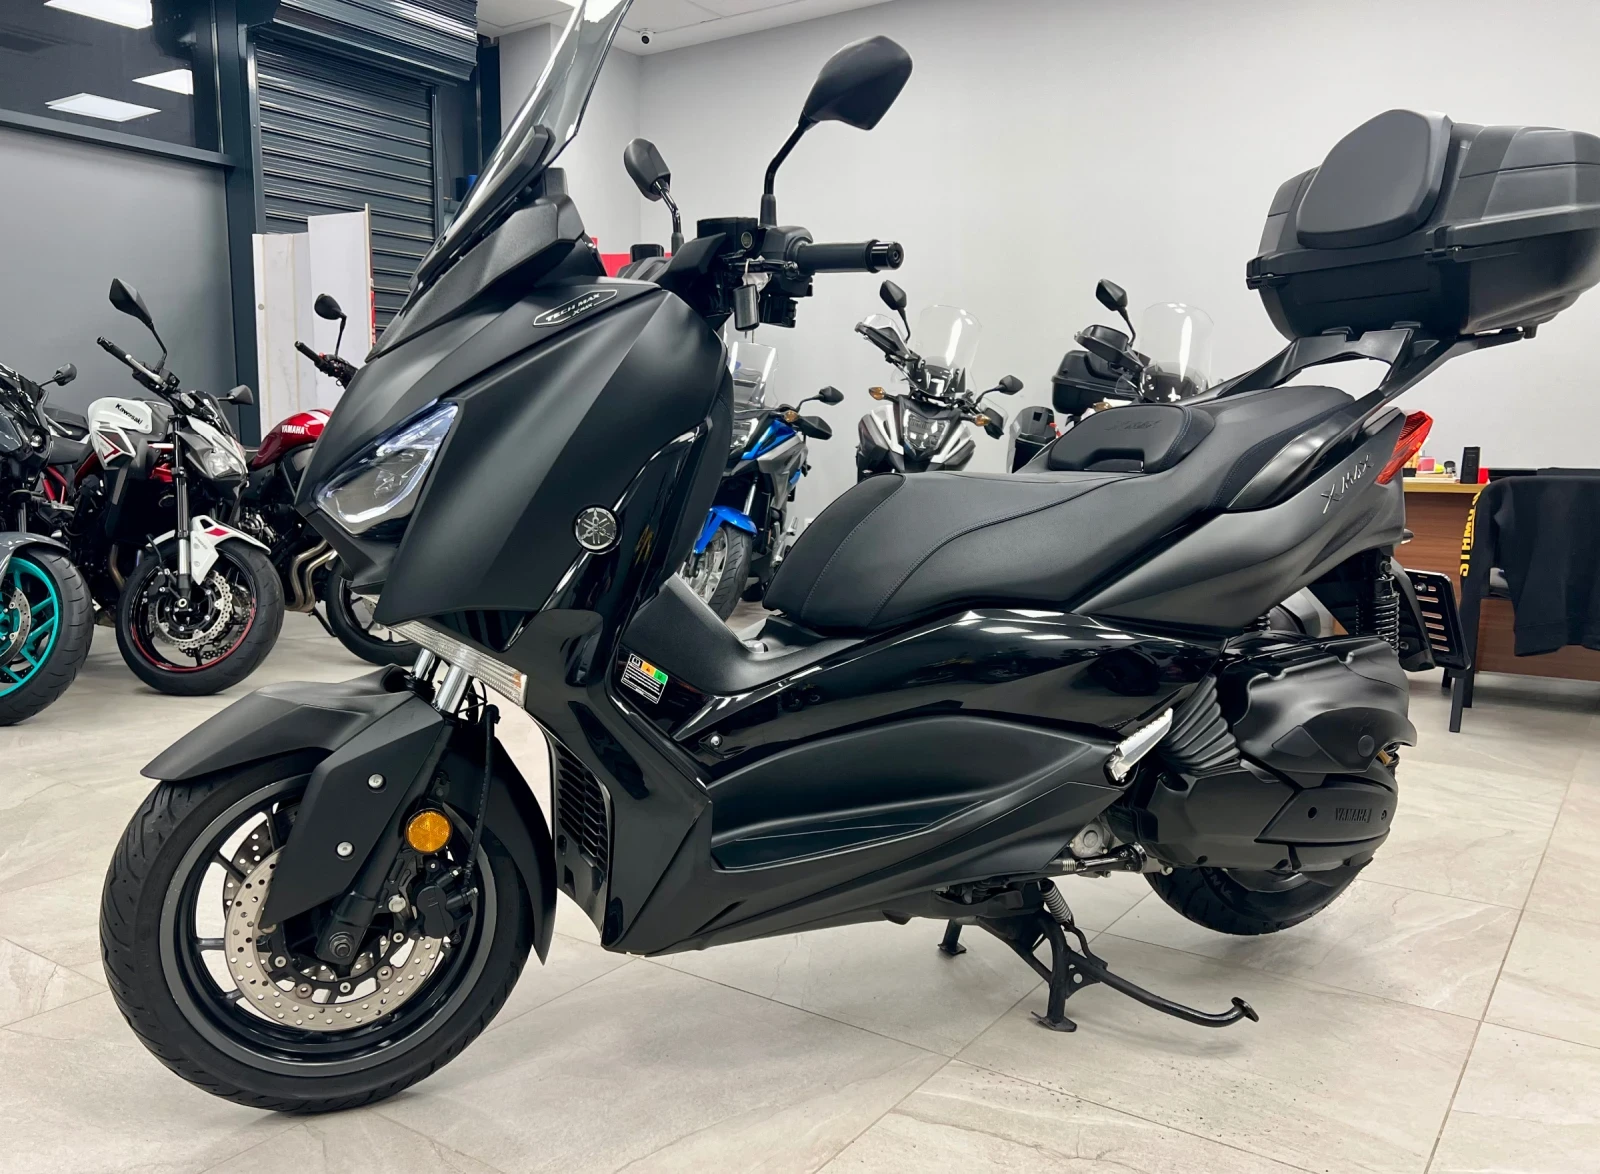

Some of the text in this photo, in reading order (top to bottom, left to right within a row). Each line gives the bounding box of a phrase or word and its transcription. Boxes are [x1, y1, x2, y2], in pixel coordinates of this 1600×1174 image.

[545, 293, 600, 322] TECH MAX
[115, 403, 143, 425] Kawasaki
[281, 424, 305, 435] YAMAHA
[1335, 807, 1372, 823] YAMAHA
